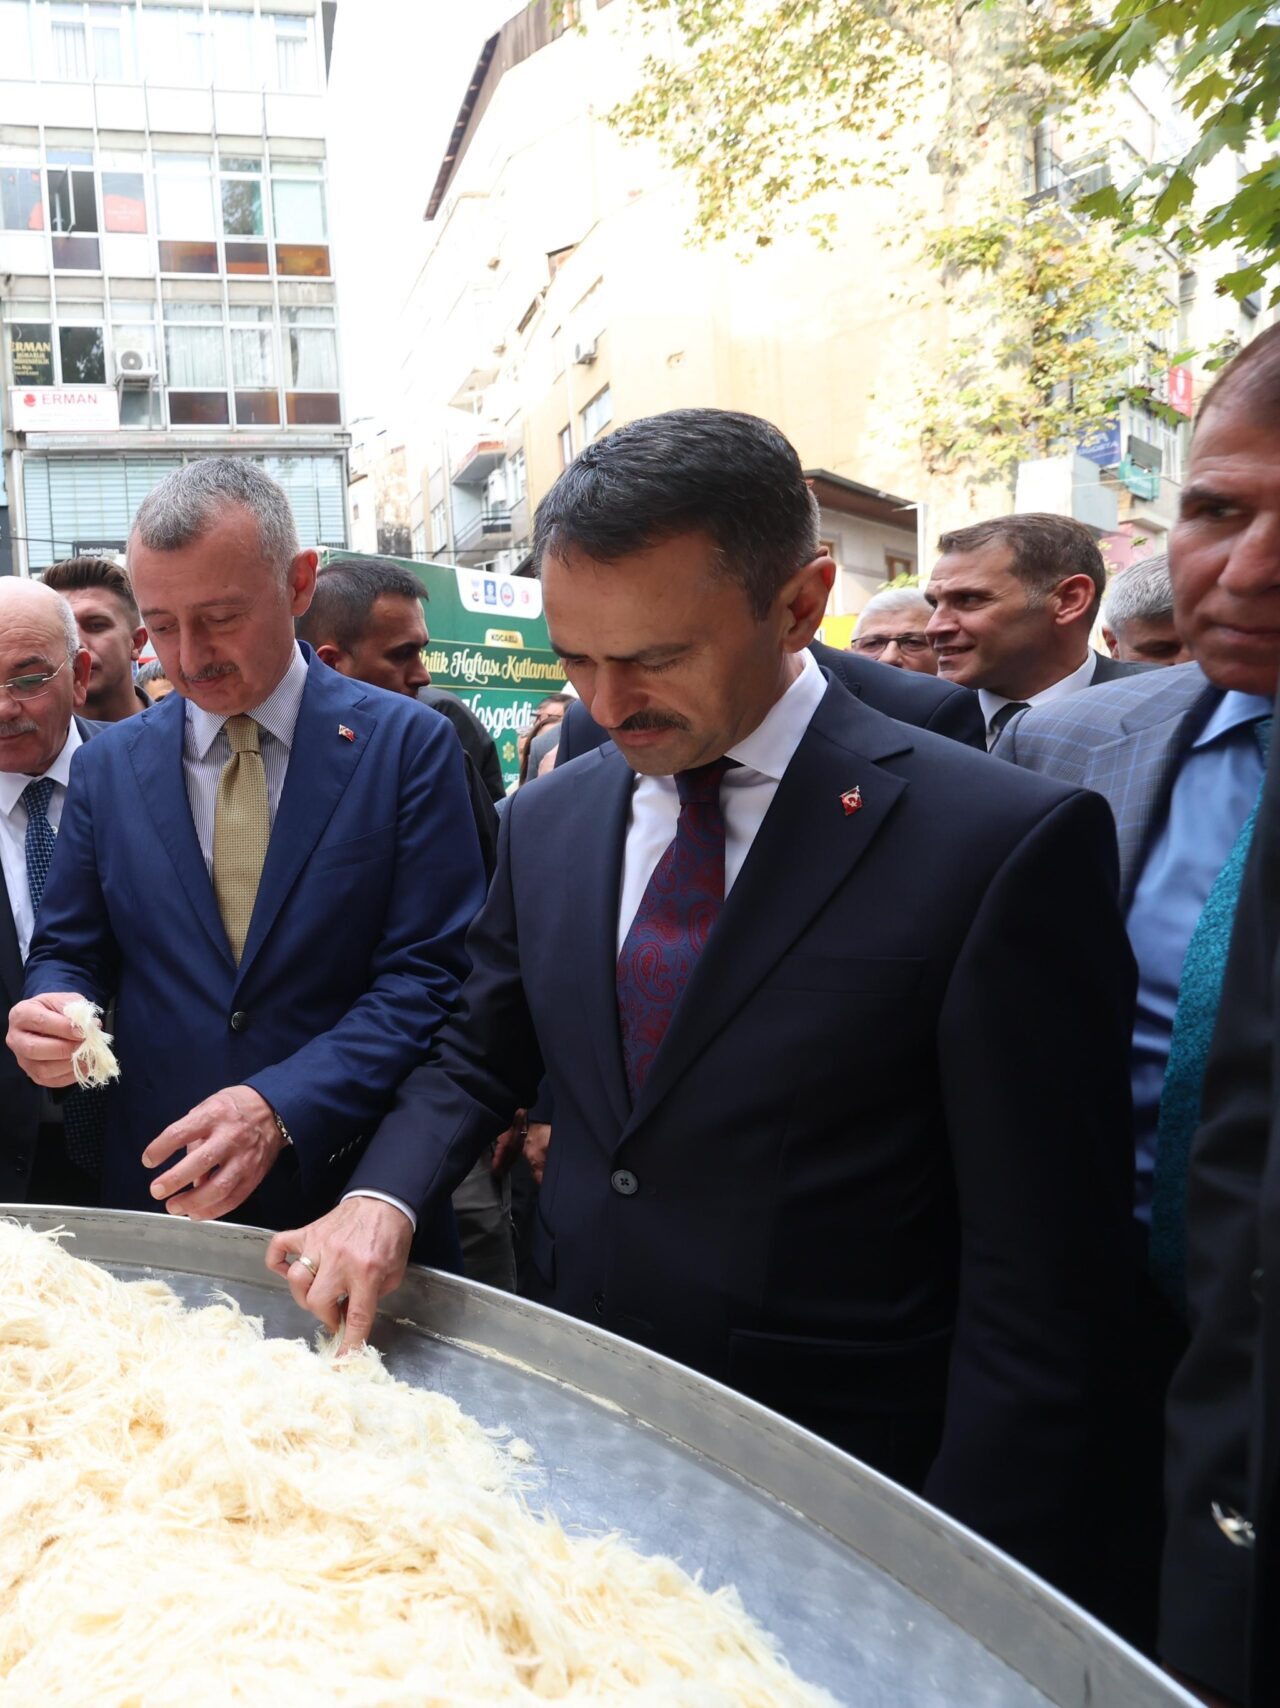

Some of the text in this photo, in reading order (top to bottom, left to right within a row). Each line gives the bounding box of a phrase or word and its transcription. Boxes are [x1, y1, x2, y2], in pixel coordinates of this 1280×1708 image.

[42, 393, 97, 405] ERMAN
[419, 649, 450, 674] hilik
[450, 648, 500, 684] Haftası
